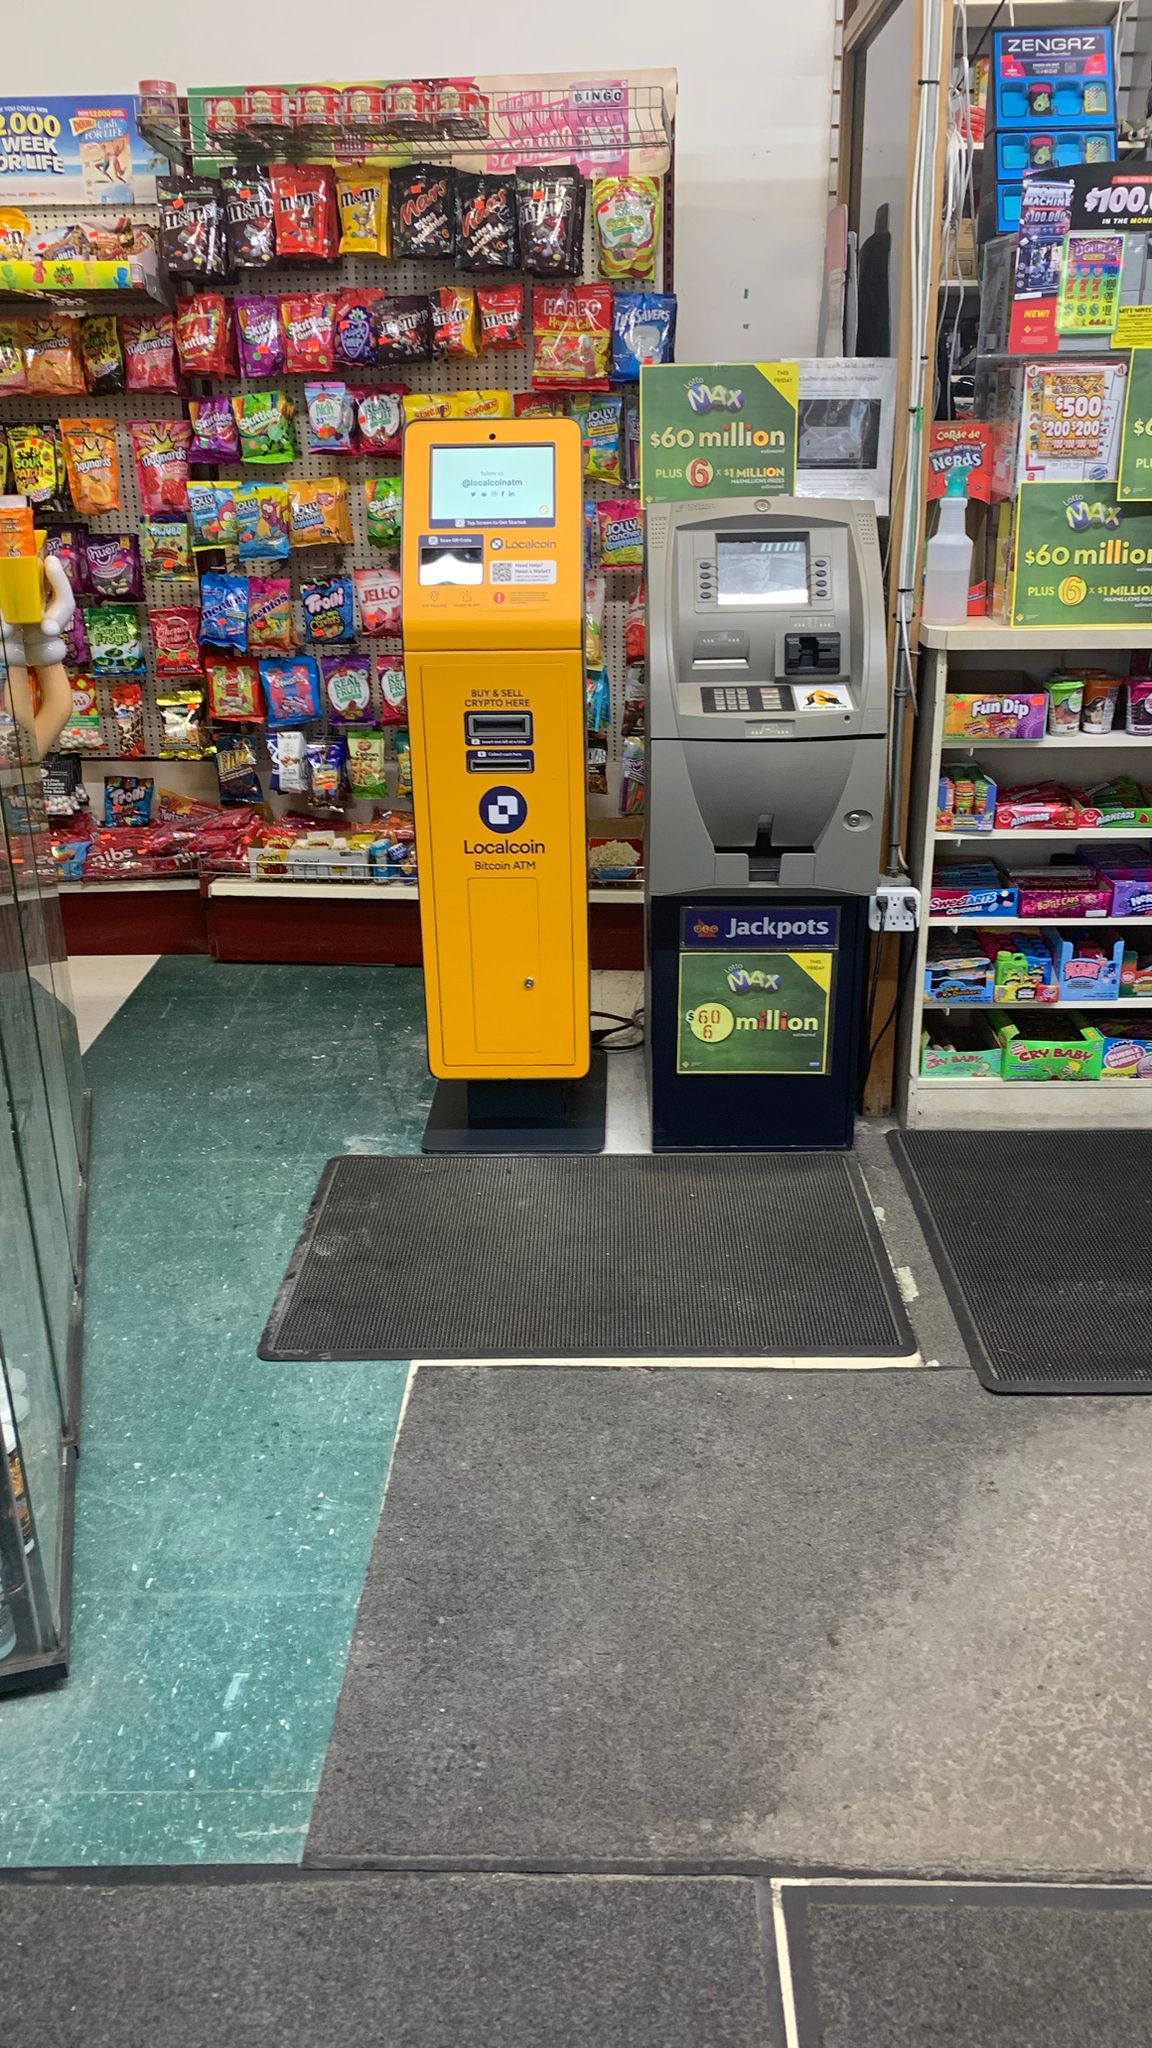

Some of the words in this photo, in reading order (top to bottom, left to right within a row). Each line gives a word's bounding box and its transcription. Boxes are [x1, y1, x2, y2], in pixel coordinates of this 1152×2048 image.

[1008, 37, 1096, 52] ZENGAZ
[575, 90, 622, 102] BINGO
[84, 130, 103, 140] FOR
[104, 127, 124, 138] LIFE
[2, 137, 59, 155] WEEK
[26, 155, 64, 174] LIFE
[1023, 197, 1071, 206] MACHINE
[1085, 187, 1152, 214] $100,
[544, 298, 601, 316] HARIBO
[1024, 309, 1050, 318] NEW!
[688, 384, 743, 412] MAX
[587, 408, 614, 422] JOLLY
[1055, 396, 1102, 418] $500
[650, 427, 694, 449] $60
[700, 421, 786, 447] million
[1042, 420, 1070, 437] $200
[1071, 420, 1100, 437] $200
[15, 457, 42, 469] SOUR
[143, 448, 188, 468] maynards
[15, 468, 43, 479] PATCH
[655, 467, 683, 479] PLUS
[689, 457, 711, 488] 6
[737, 466, 786, 479] MILLION
[462, 479, 523, 489] @localcoinatm
[1065, 501, 1122, 529] MAX
[607, 520, 638, 535] JOLLY
[505, 538, 557, 550] Localcoin
[88, 542, 120, 567] huer
[1025, 543, 1071, 567] $60
[363, 586, 400, 603] JELL-O
[1028, 586, 1055, 597] PLUS
[1062, 576, 1083, 606] 6
[1110, 585, 1152, 596] MILLIO
[248, 592, 289, 626] mentos
[305, 588, 344, 614] Trolli
[333, 679, 361, 689] REAL
[471, 689, 490, 698] BUY
[493, 689, 499, 698] &
[501, 689, 524, 698] SELL
[464, 698, 504, 708] CRYPTO
[506, 698, 531, 707] HERE
[971, 700, 1000, 718] Fun
[1002, 699, 1031, 720] Dip
[108, 787, 146, 805] Trolli
[1010, 812, 1051, 828] AIRHEADS
[1096, 811, 1136, 826] AIRHEADS
[464, 839, 546, 855] Localcoin
[92, 849, 134, 863] nibs
[474, 861, 511, 870] Bitcoin
[512, 861, 536, 870] ATM
[946, 906, 984, 916] ORIGINAL
[725, 917, 830, 939] Jackpots
[727, 969, 781, 993] MAX
[736, 1009, 819, 1031] million
[1019, 1048, 1051, 1063] CRY
[1053, 1048, 1094, 1062] BABY
